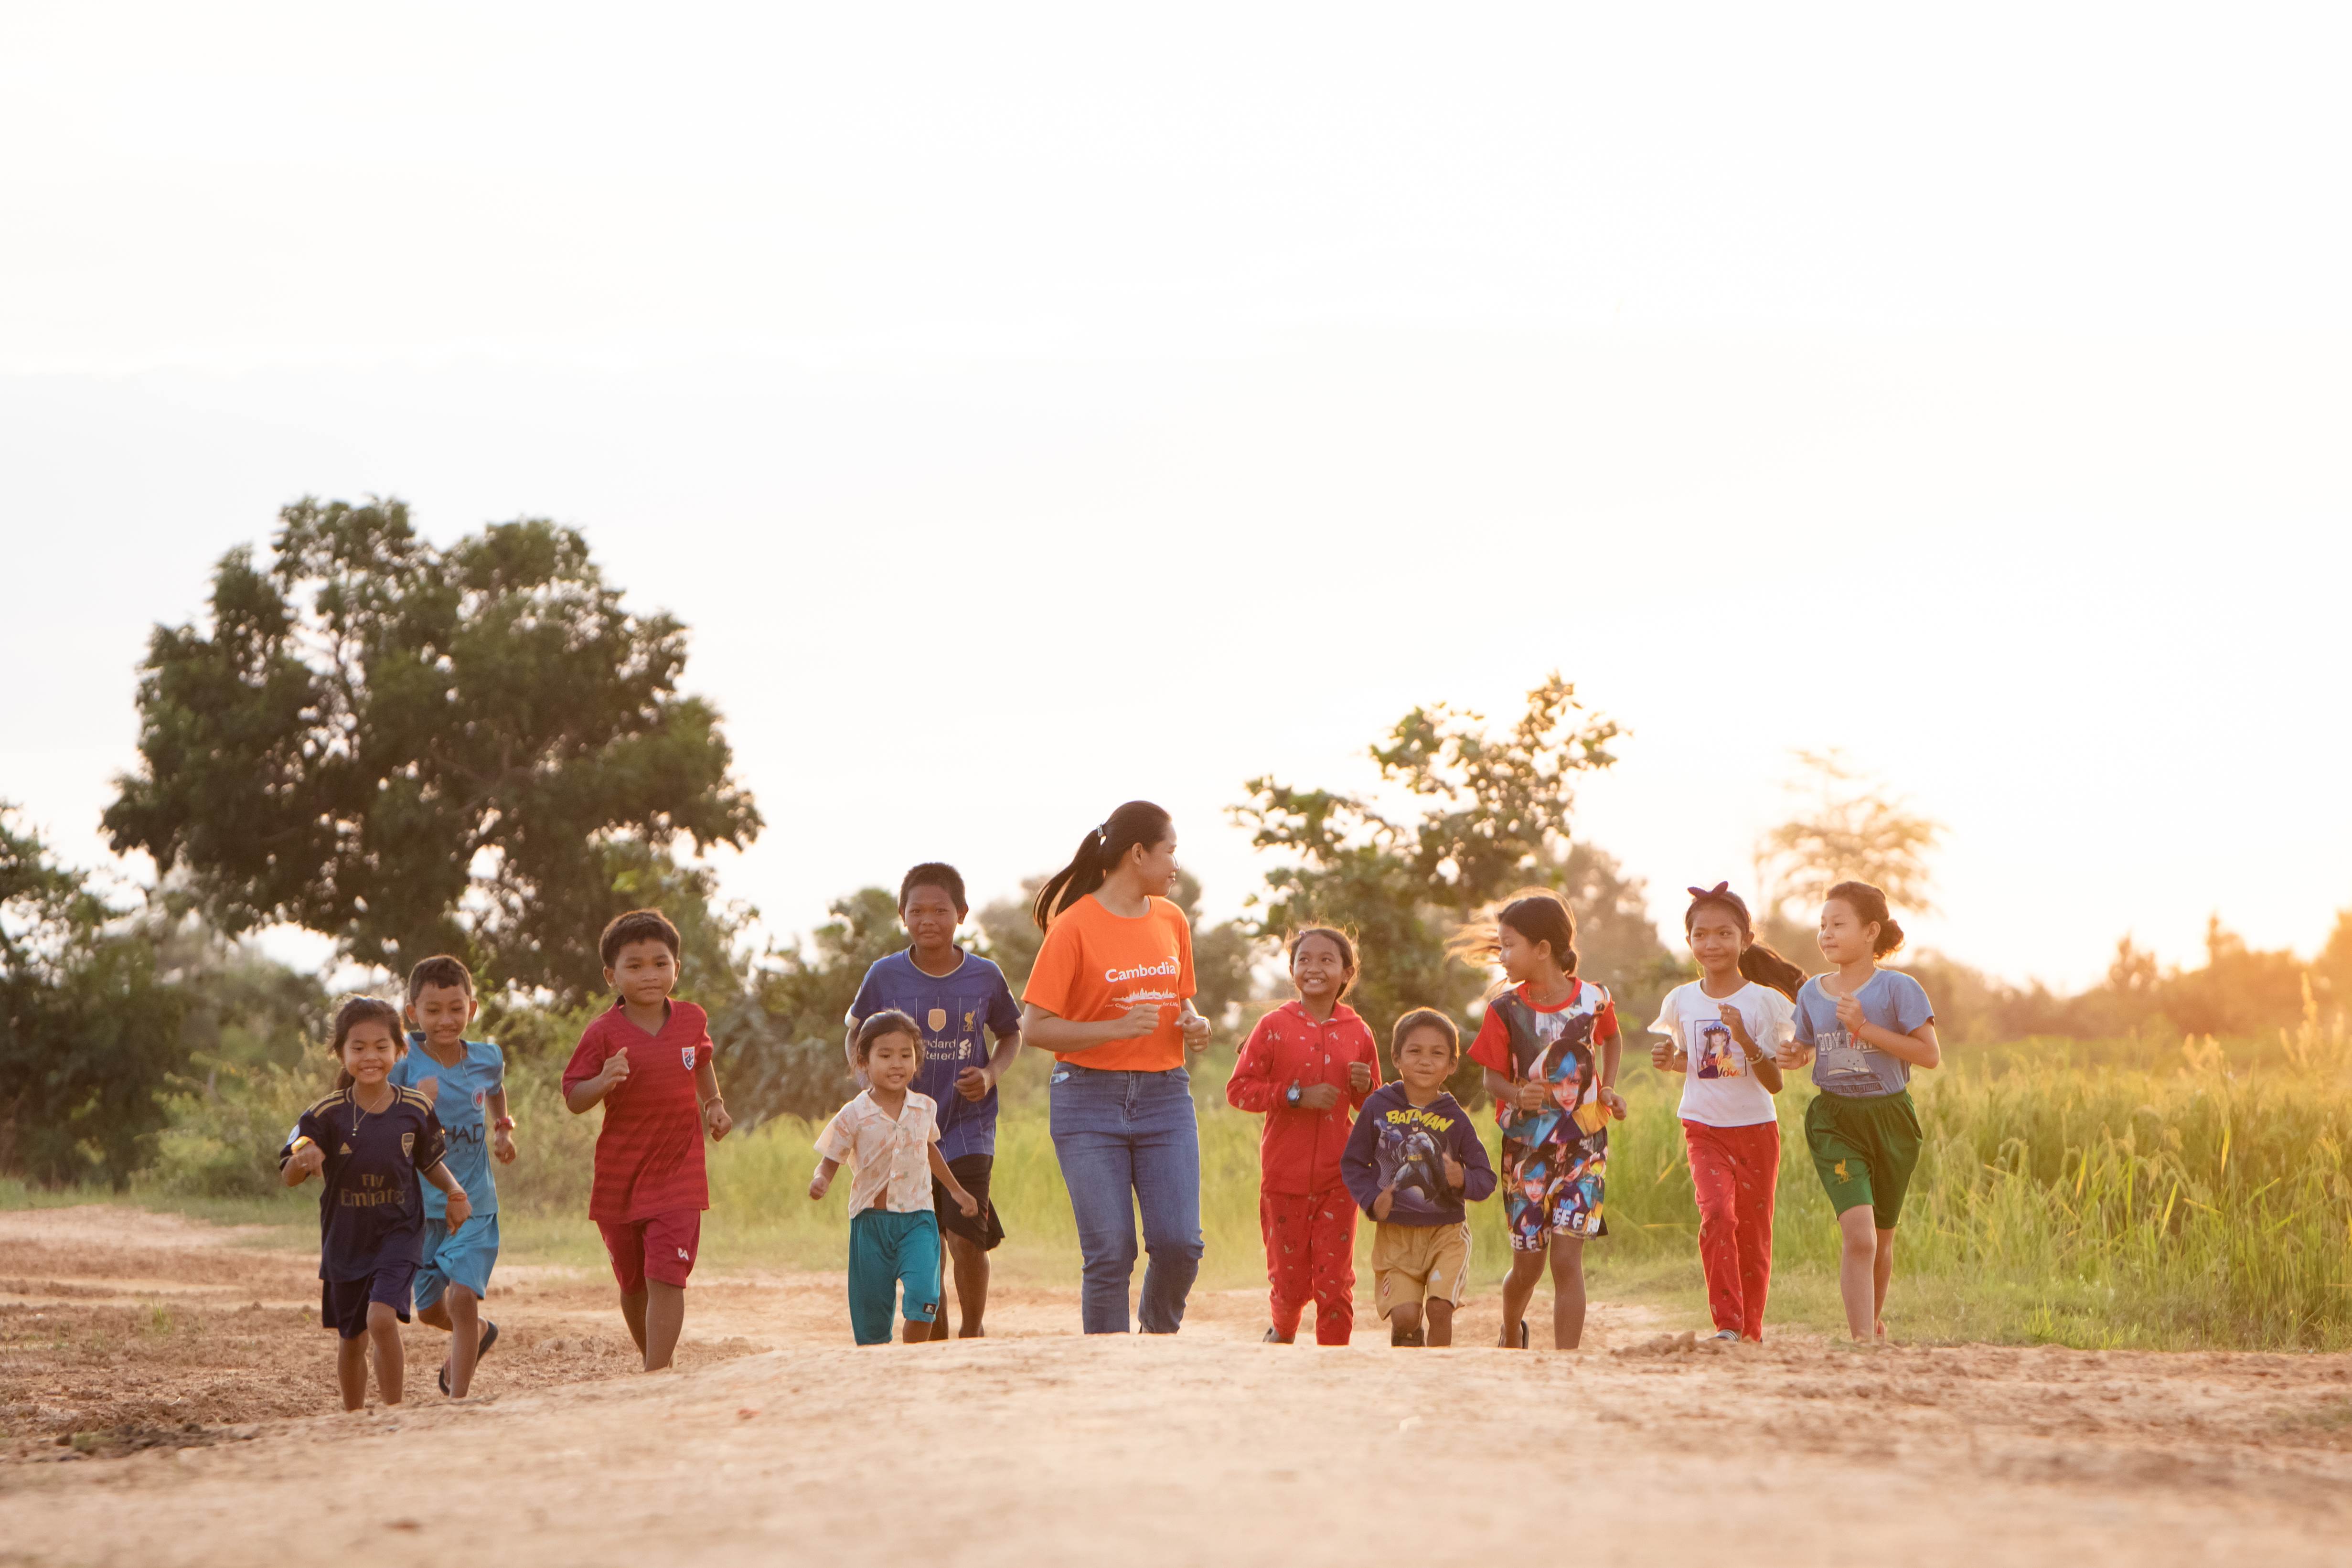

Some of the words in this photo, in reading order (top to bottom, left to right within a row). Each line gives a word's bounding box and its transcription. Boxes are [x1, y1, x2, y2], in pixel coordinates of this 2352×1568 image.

[1105, 961, 1176, 982] Cambodia
[1386, 1109, 1454, 1132] BATMAN
[362, 1174, 384, 1187] Fly
[341, 1187, 405, 1207] Emirates
